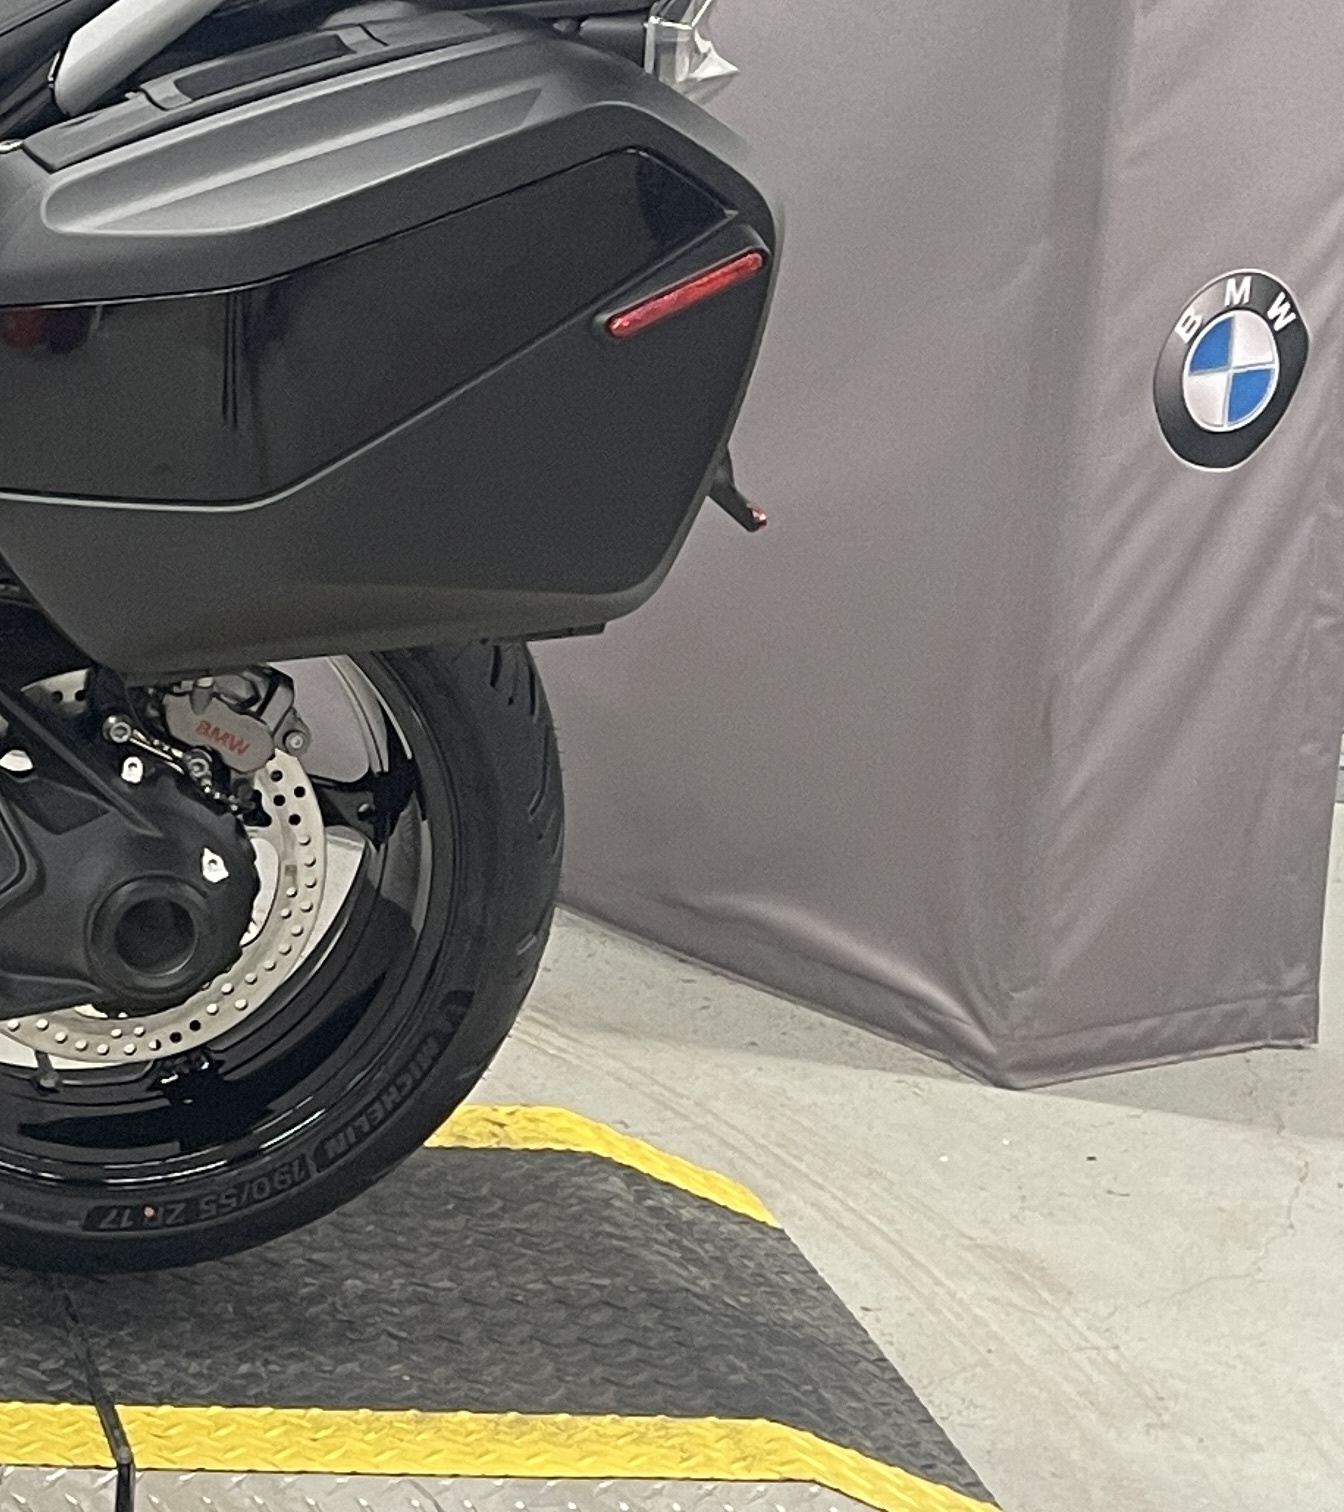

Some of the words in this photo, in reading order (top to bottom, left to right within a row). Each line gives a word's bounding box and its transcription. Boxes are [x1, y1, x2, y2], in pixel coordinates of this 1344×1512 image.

[1173, 275, 1298, 345] BMW
[194, 719, 250, 756] BMW
[323, 1034, 441, 1161] MICHELIN
